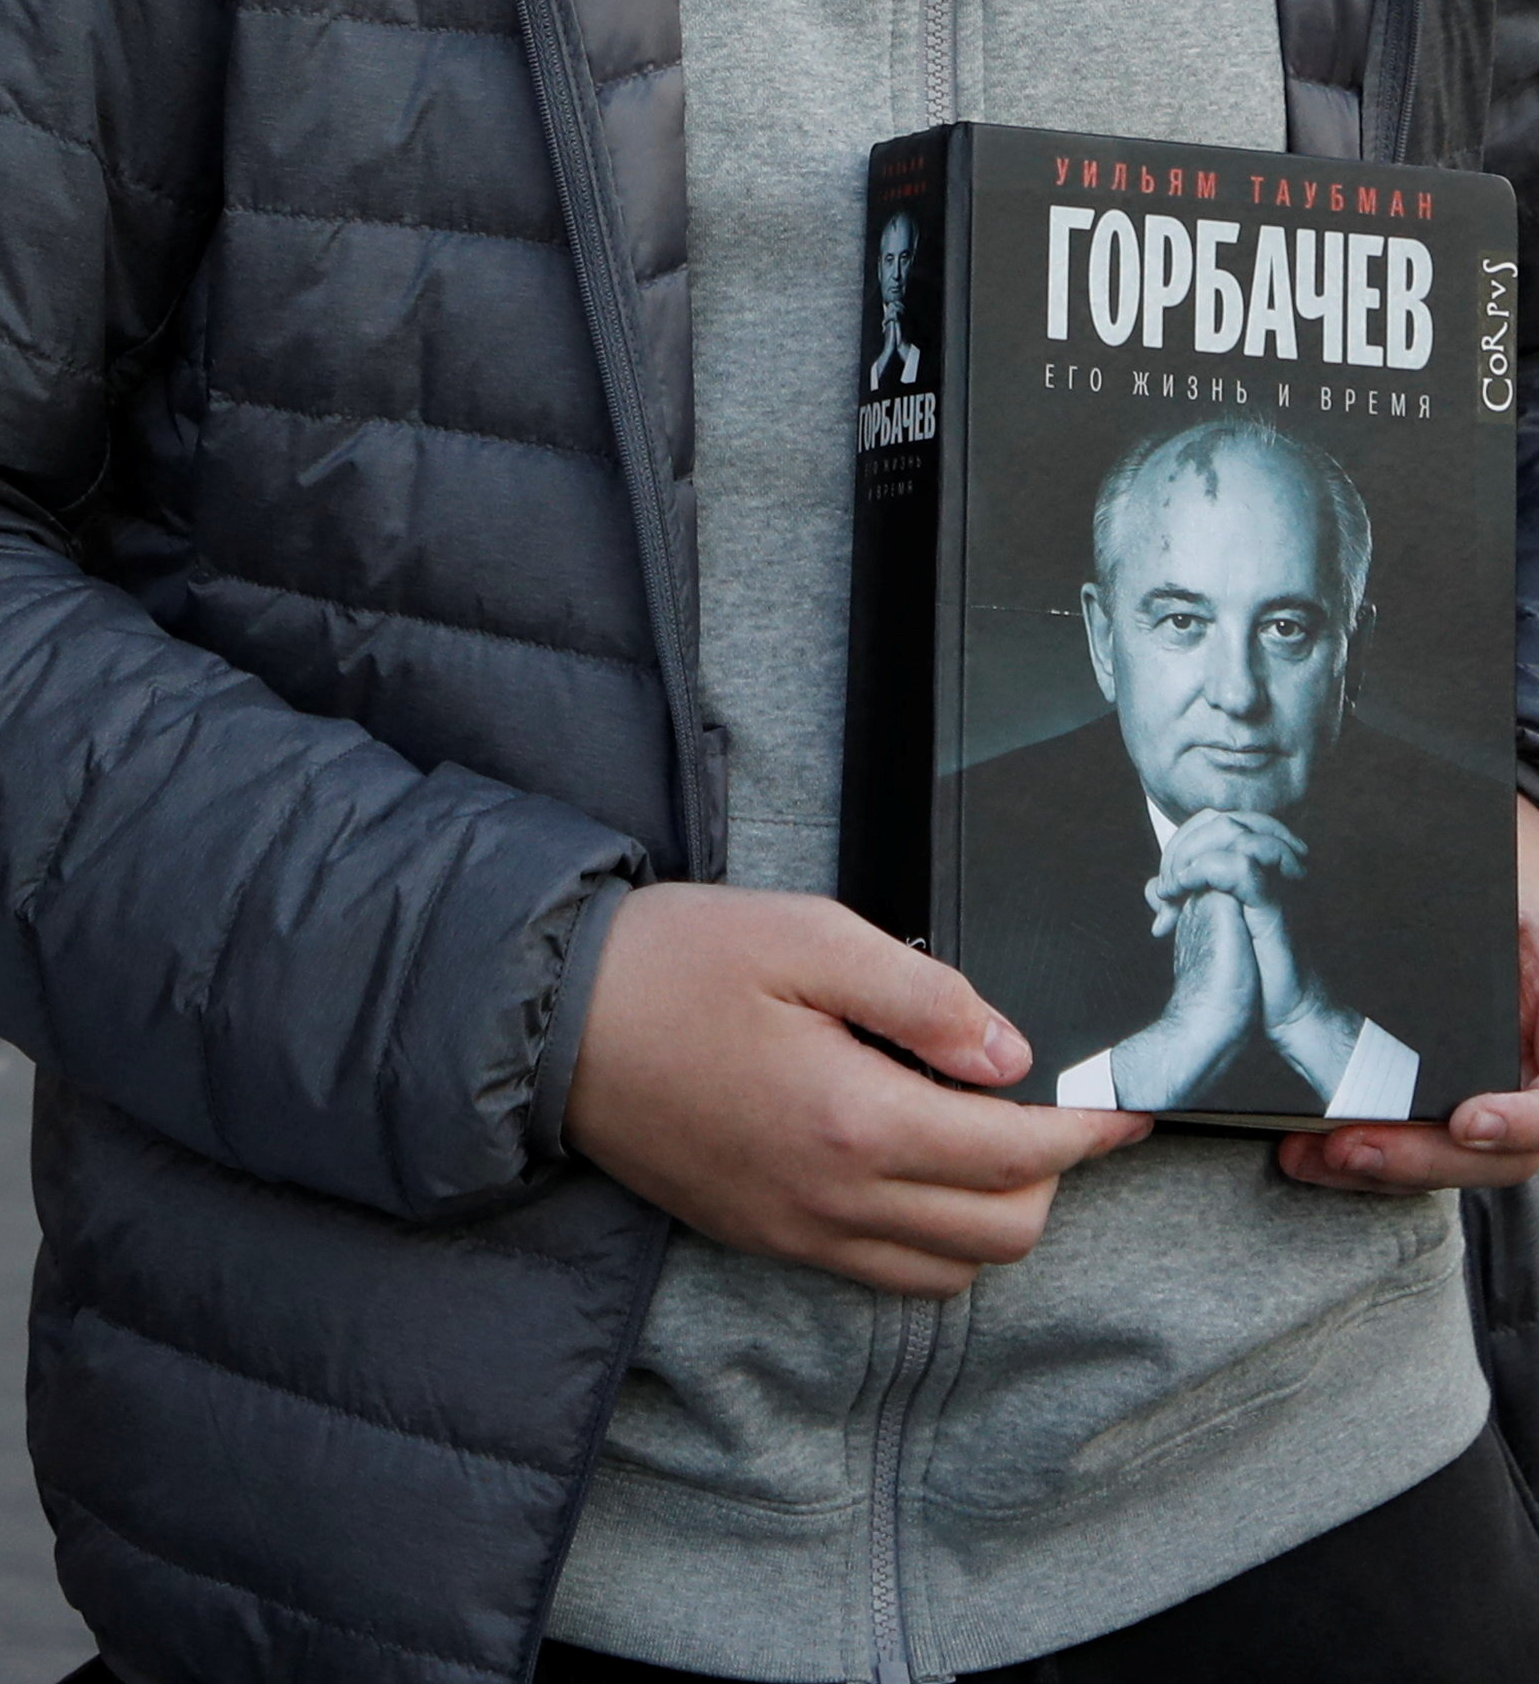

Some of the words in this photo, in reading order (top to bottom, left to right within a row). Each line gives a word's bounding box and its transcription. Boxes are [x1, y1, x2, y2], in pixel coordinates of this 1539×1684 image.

[1055, 156, 1218, 198] УИЛЬЯМ
[1251, 176, 1433, 220] ТАУБМАН
[1047, 204, 1434, 370] ГОРБАЧЕВ
[858, 391, 937, 453] ГОРБАЧЕВ
[1045, 364, 1102, 392] ЕГО
[1132, 370, 1248, 405] ЖИЗНЬ
[1278, 379, 1291, 407] И
[1320, 386, 1431, 419] ВРЕМЯ
